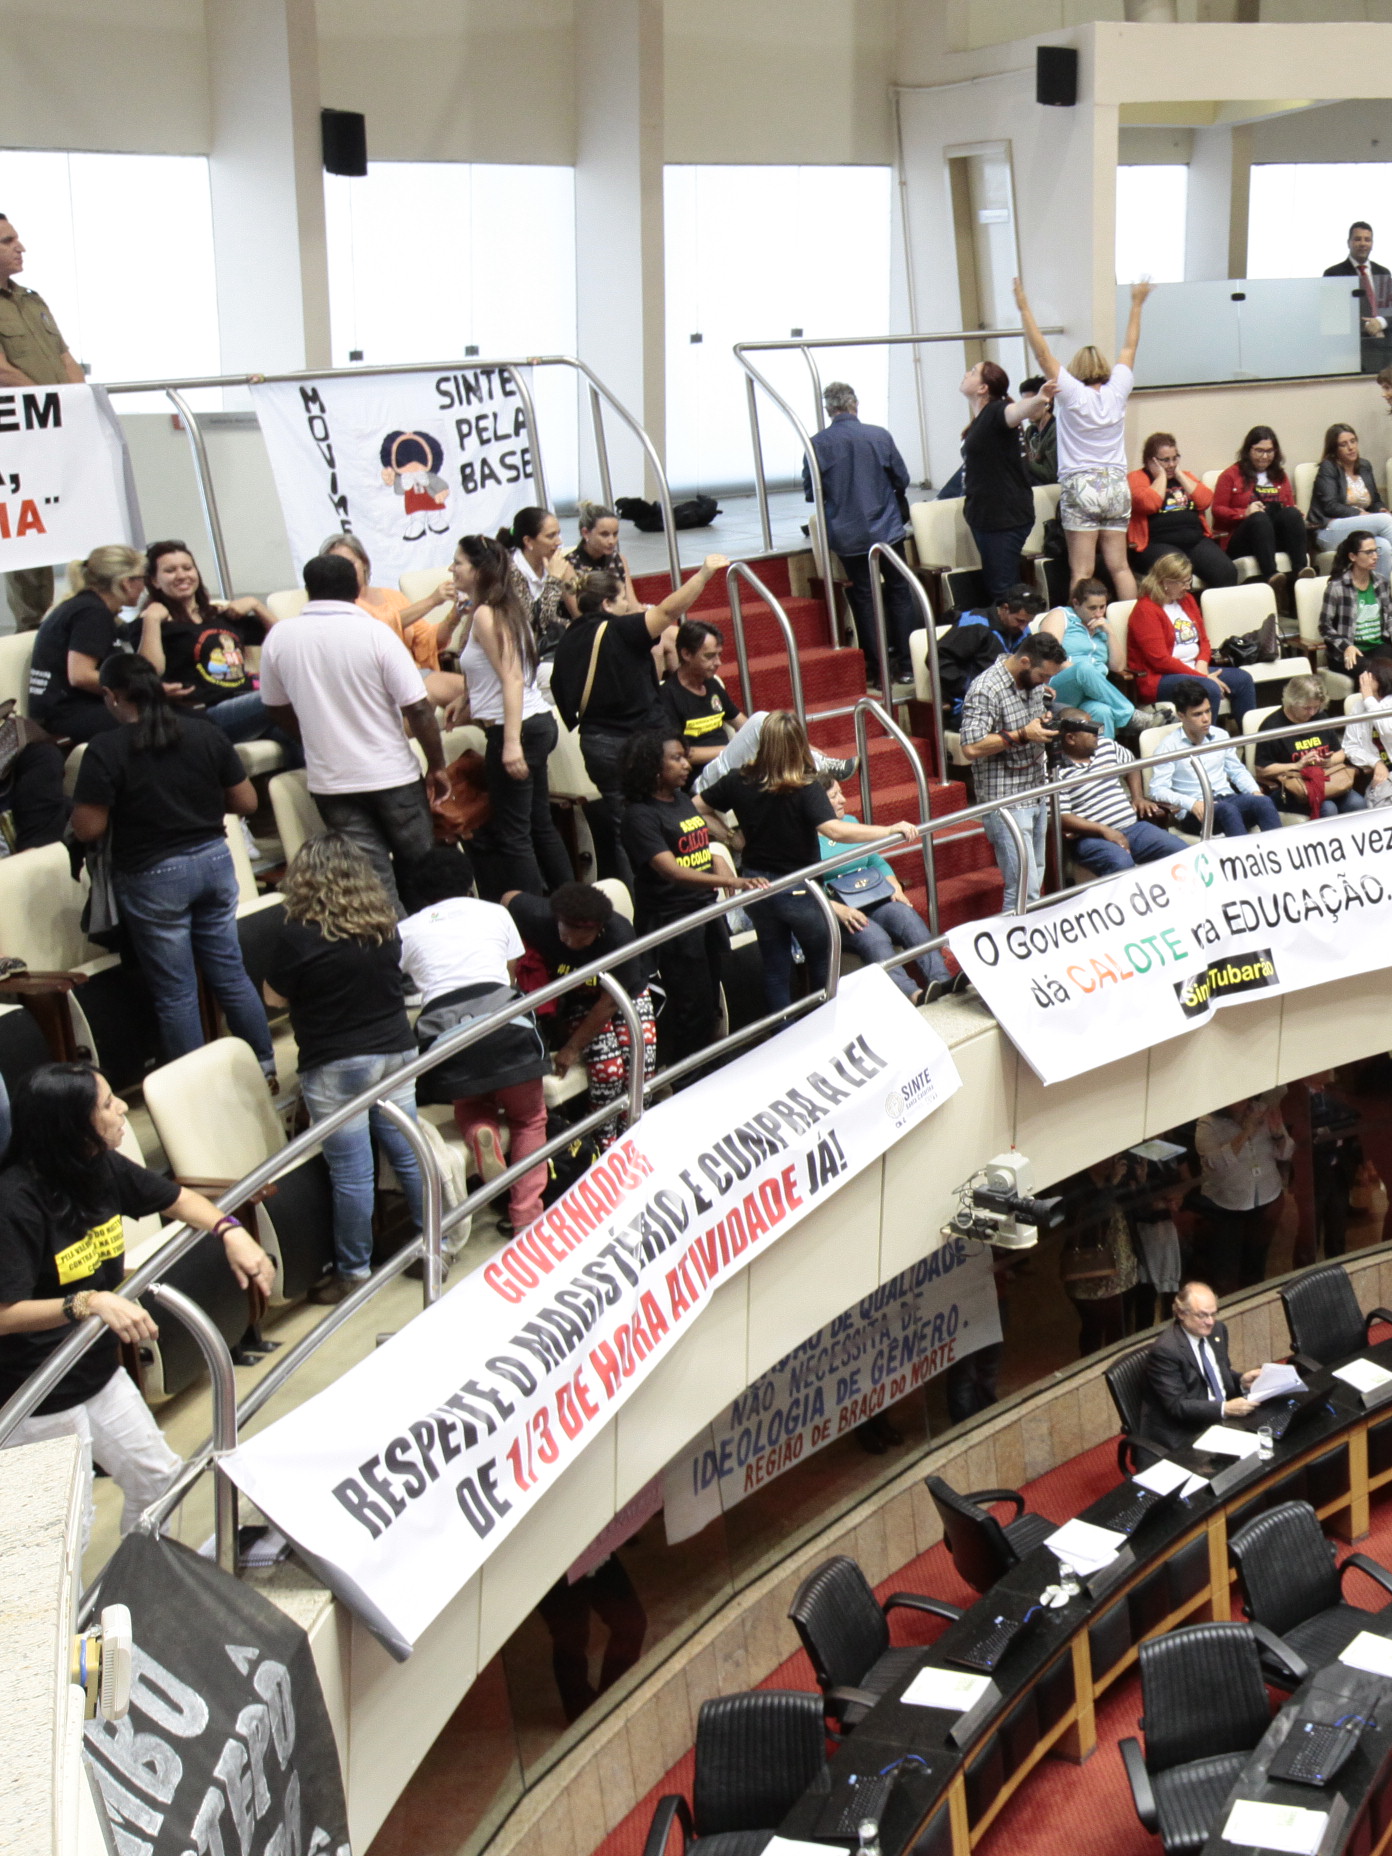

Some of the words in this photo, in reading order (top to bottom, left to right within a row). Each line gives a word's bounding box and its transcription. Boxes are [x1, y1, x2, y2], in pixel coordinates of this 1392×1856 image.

[435, 368, 517, 410] SINTE
[456, 407, 527, 451] PELA
[460, 448, 533, 494] BASE
[974, 932, 999, 966] O
[1006, 902, 1125, 960] Governo
[1129, 882, 1170, 917] de
[1220, 844, 1282, 882] mais
[1287, 837, 1346, 871] uma
[1030, 974, 1071, 1009] dá
[1066, 927, 1189, 994] CALOTE
[1221, 872, 1392, 935] EDUCAÇÃO.
[806, 1071, 852, 1106] A
[828, 1033, 888, 1088] LEI
[901, 1067, 932, 1101] SINTE
[678, 1169, 713, 1216] E
[697, 1088, 831, 1196] CUMPRA
[483, 1139, 655, 1304] GOVERNADOR
[455, 1456, 513, 1541] DE
[506, 1406, 559, 1493] 1/3
[555, 1363, 600, 1441] DE
[589, 1289, 670, 1401] HORA
[665, 1163, 804, 1323] ATIVIDADE
[806, 1128, 848, 1196] JÁ!
[508, 1189, 690, 1376] MAGISTÉRIO
[830, 1309, 855, 1340] DE
[859, 1236, 968, 1321] QUALIDADE
[485, 1356, 538, 1398] O
[693, 1385, 825, 1496] IDEOLOGIA
[836, 1374, 862, 1405] DE
[870, 1304, 969, 1387] GÊNERO.
[729, 1378, 775, 1431] NÃO
[744, 1432, 804, 1493] REGIÃO
[811, 1420, 832, 1448] DE
[838, 1379, 886, 1431] BRAÇO
[890, 1378, 907, 1401] DO
[911, 1338, 957, 1385] NORTE
[331, 1379, 516, 1541] RESPEITE
